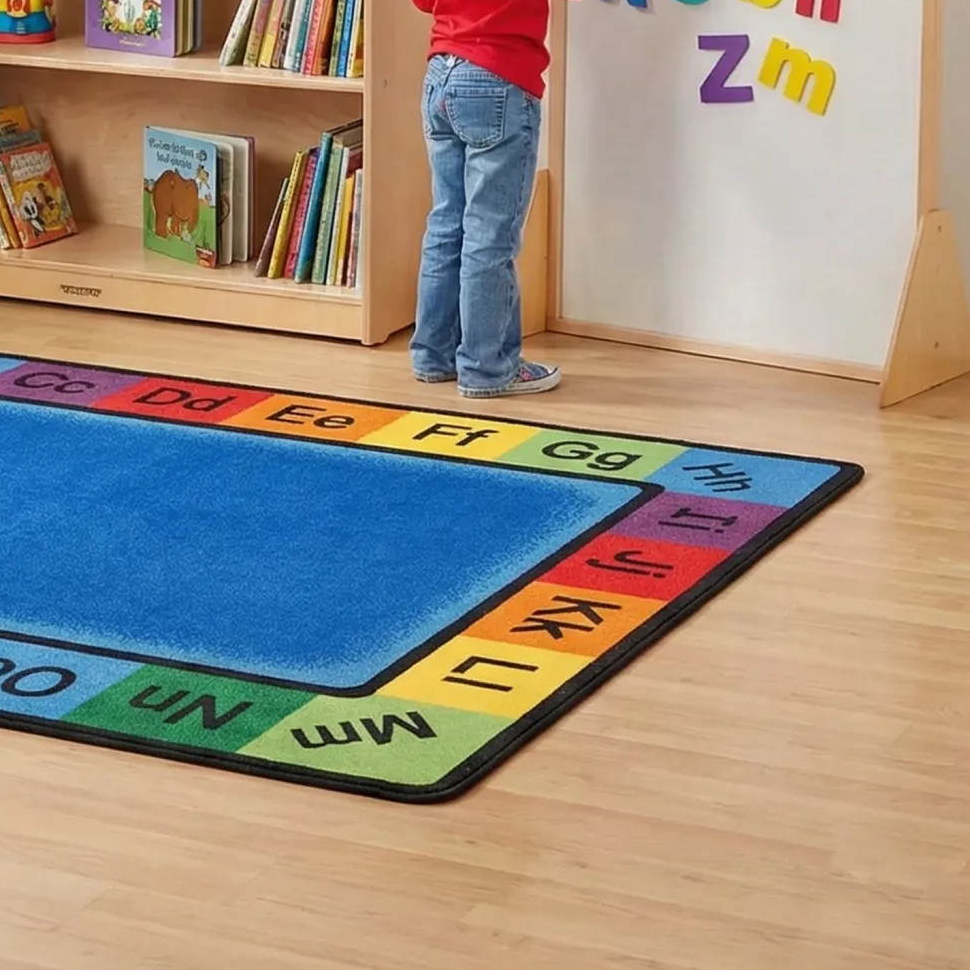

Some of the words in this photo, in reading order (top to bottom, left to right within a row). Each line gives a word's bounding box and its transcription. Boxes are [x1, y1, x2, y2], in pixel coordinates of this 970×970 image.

[758, 37, 836, 116] m
[12, 372, 95, 395] Cc
[133, 387, 236, 413] Dd
[265, 404, 356, 429] Ee
[412, 423, 499, 447] Ff
[541, 441, 640, 472] Gg
[681, 462, 753, 493] Hh
[585, 550, 674, 579] Jj
[509, 595, 623, 640] Kk
[129, 684, 254, 731] Nn
[290, 711, 438, 749] Mm
